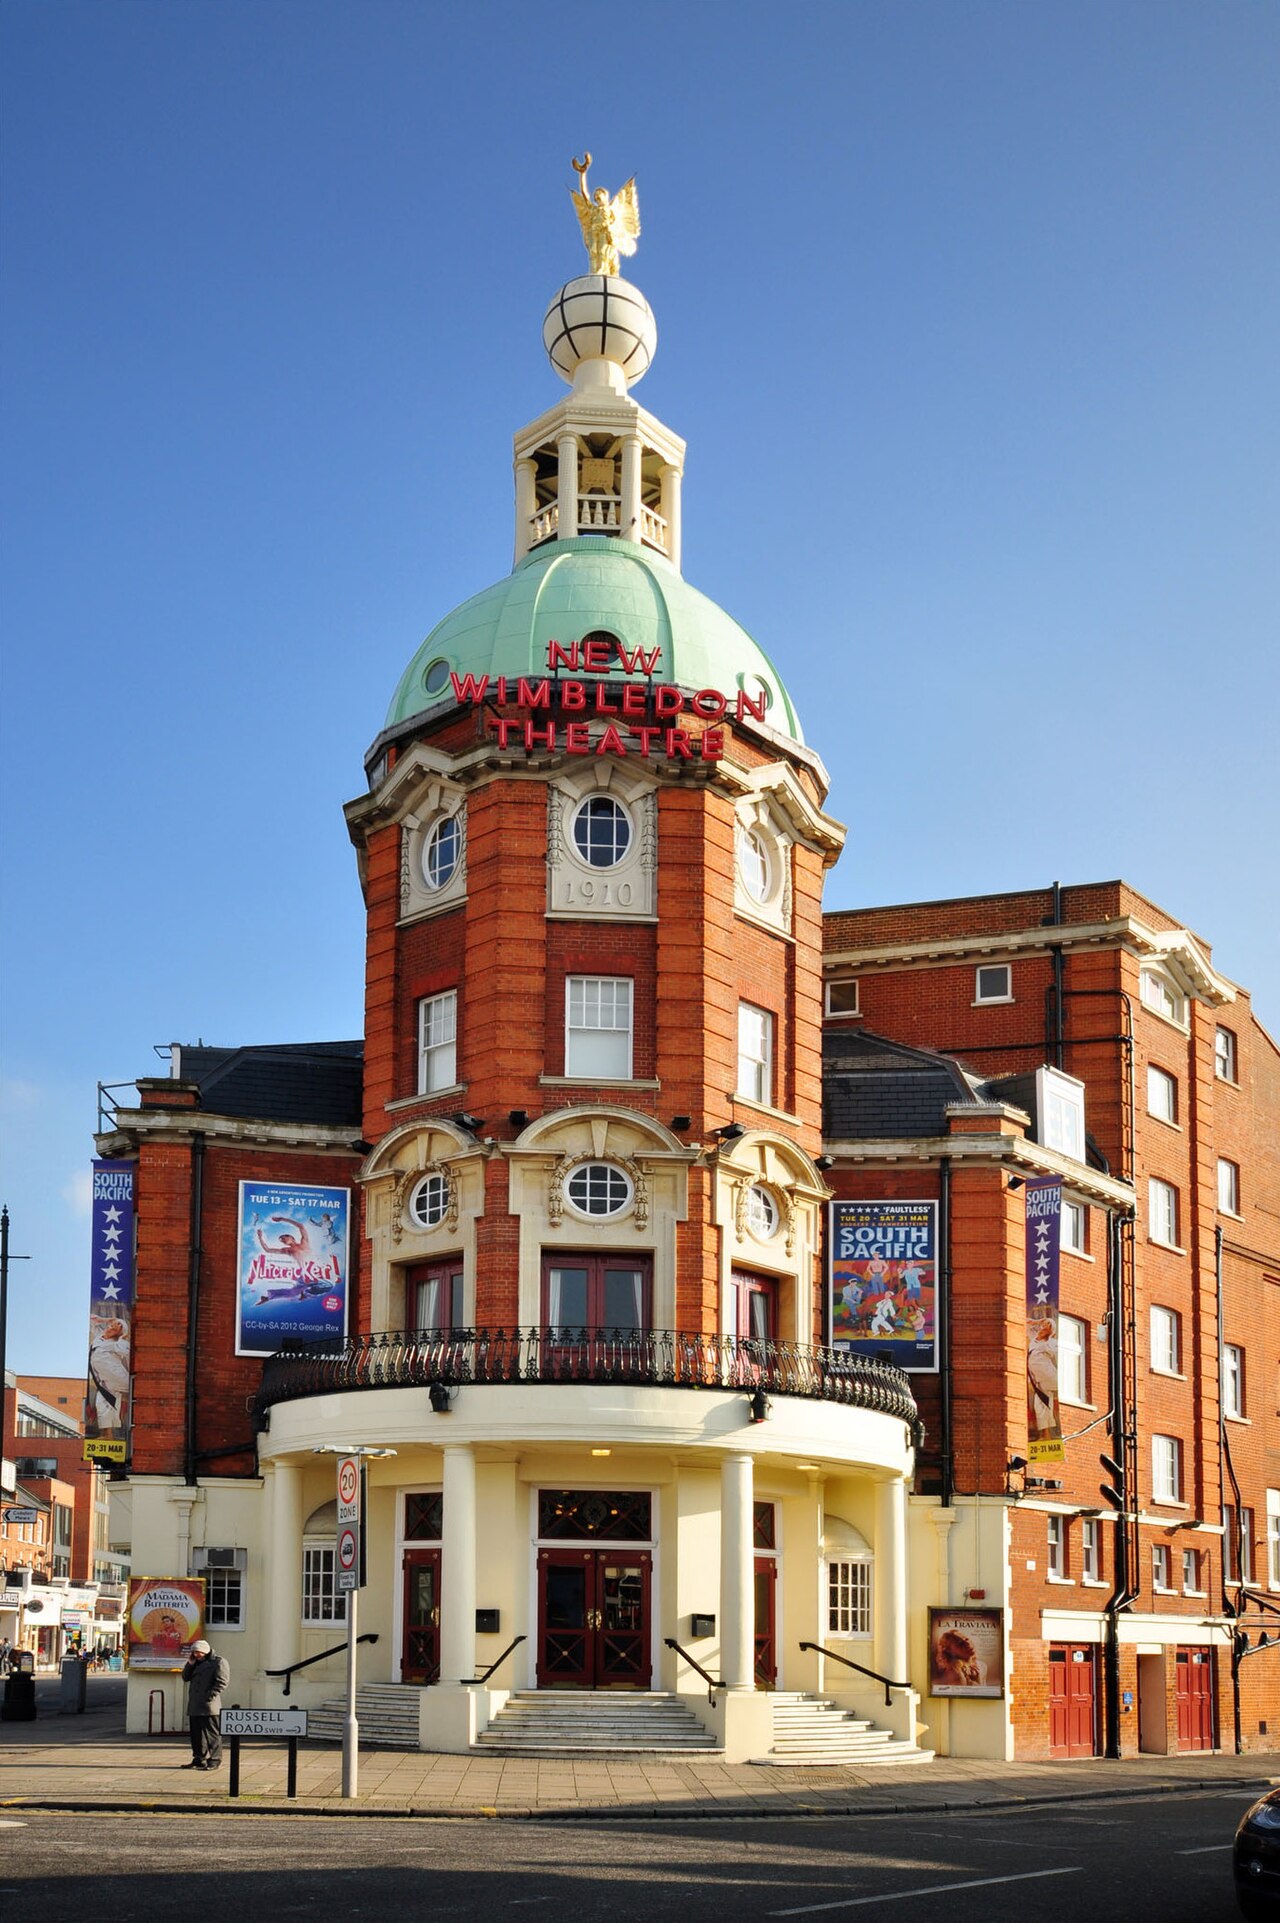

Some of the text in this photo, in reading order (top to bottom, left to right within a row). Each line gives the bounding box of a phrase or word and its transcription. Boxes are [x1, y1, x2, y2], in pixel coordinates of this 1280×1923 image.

[547, 640, 661, 675] NEW
[450, 672, 766, 722] WIMBLEDON
[488, 719, 724, 761] THEATRE
[565, 881, 633, 907] 1910
[95, 1173, 132, 1186] SOUTH
[95, 1187, 132, 1200] PACIFIC
[1026, 1187, 1060, 1205] SOUTH
[250, 1195, 269, 1203] TUE
[270, 1196, 281, 1204] 13
[288, 1197, 307, 1206] SAT
[308, 1199, 318, 1207] 17
[320, 1200, 341, 1209] MAR
[1026, 1201, 1060, 1218] PACIFIC
[840, 1227, 928, 1243] SOUTH
[840, 1243, 928, 1258] PACIFIC
[108, 1445, 124, 1453] MAR
[1048, 1444, 1061, 1452] MAR
[342, 1473, 355, 1491] 20
[340, 1506, 356, 1519] ZONE
[146, 1592, 188, 1601] MADAMA
[144, 1600, 190, 1608] BUTTERFLY
[938, 1619, 950, 1628] LA
[954, 1619, 997, 1628] TRAVIATA
[226, 1711, 284, 1721] RUSSELL
[226, 1724, 264, 1733] ROAD
